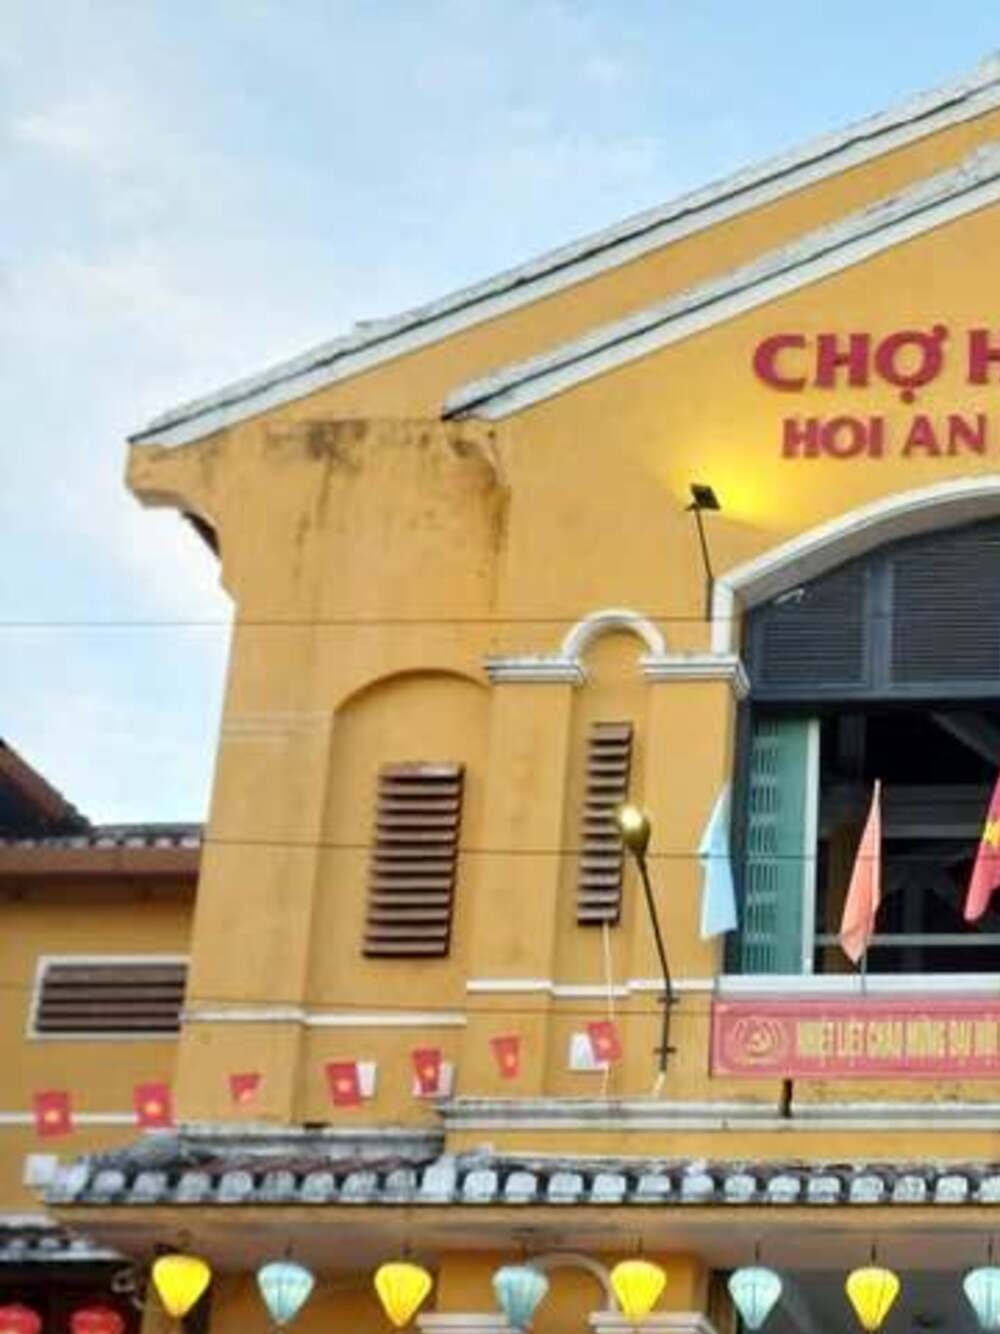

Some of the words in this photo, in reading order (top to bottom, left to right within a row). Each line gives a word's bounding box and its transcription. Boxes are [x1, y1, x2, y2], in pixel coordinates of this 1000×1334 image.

[752, 325, 948, 402] CHỢ
[781, 417, 886, 458] HOI
[901, 414, 989, 456] AN
